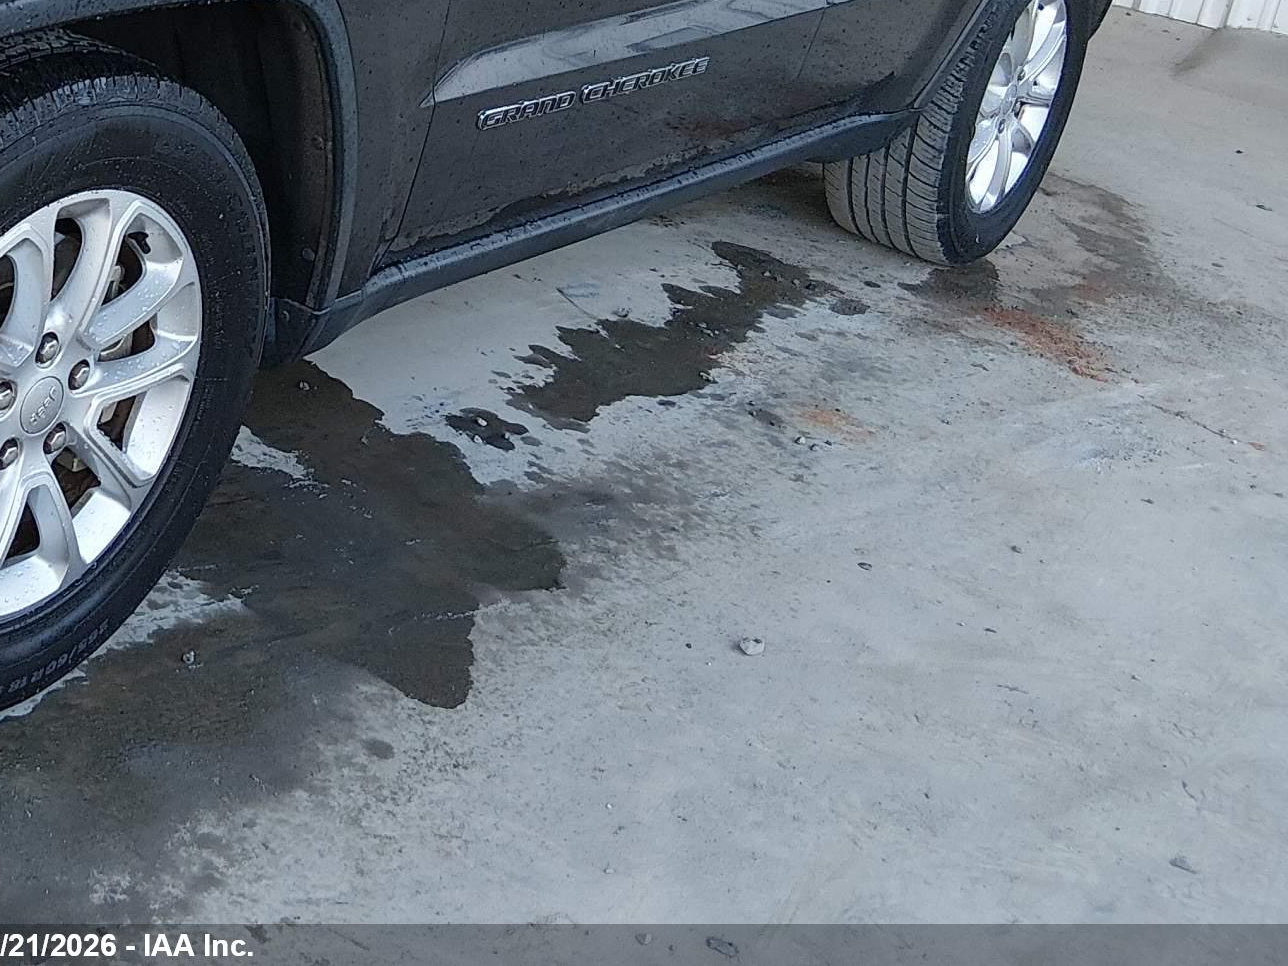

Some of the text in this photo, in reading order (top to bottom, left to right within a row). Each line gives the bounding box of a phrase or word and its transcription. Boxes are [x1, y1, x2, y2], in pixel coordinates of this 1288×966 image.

[476, 56, 710, 131] GRAND CHEROKEE
[29, 385, 57, 425] Jeep
